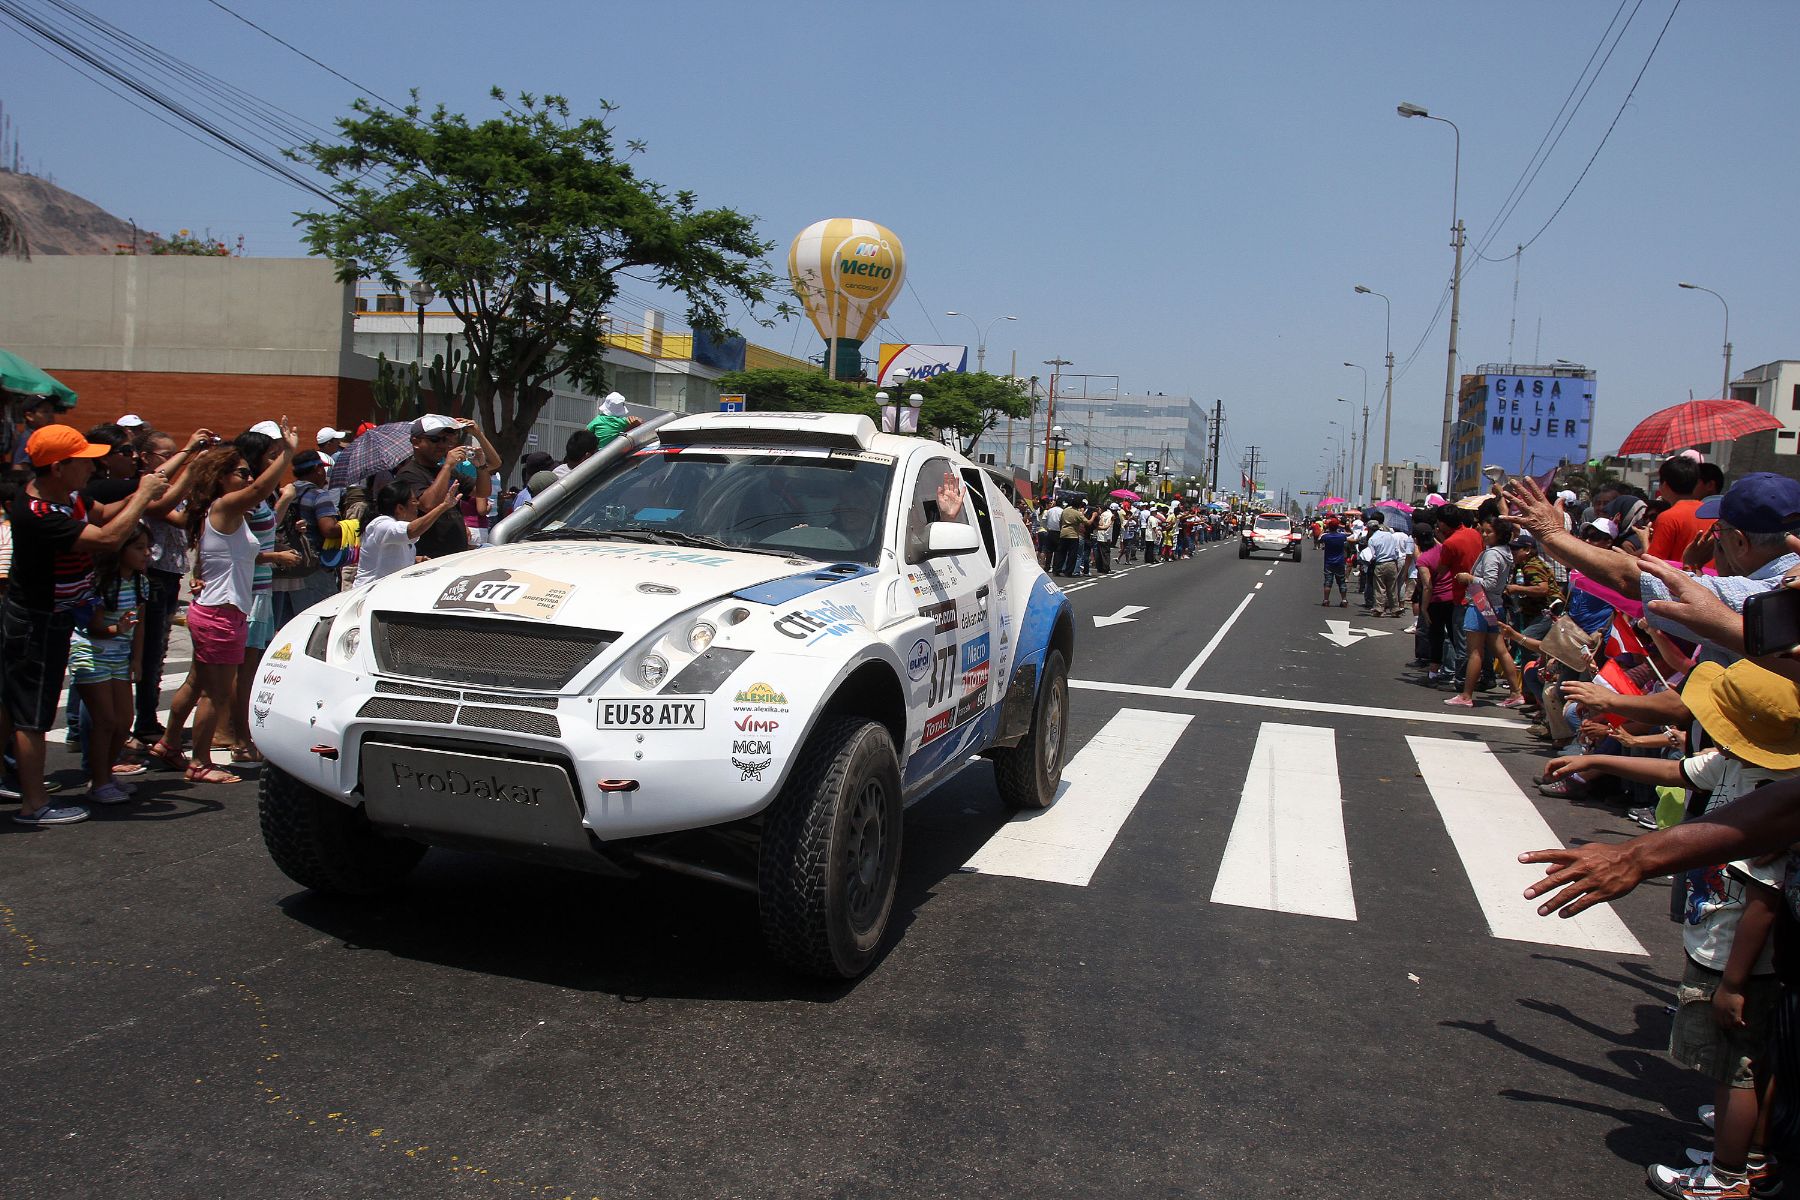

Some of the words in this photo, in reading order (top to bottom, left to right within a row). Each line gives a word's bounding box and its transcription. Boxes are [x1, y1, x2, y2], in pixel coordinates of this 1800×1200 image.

[841, 259, 891, 279] Metro
[1496, 379, 1561, 397] CASA
[1499, 400, 1519, 414] DE
[1535, 402, 1555, 415] LA
[1492, 417, 1576, 436] MUJER
[834, 451, 890, 465] dakar.com
[474, 583, 520, 601] 377
[522, 595, 560, 604] ARGENTINA
[536, 602, 556, 610] CHILE
[961, 609, 988, 630] dakar.com
[910, 652, 928, 670] eurol
[927, 644, 957, 708] 377
[969, 667, 988, 689] TOTAL
[735, 690, 788, 704] ALEXIKA
[604, 704, 654, 725] EU58
[658, 704, 696, 725] ATX
[733, 705, 789, 714] www.alexika.eu
[734, 714, 780, 733] VIMP
[926, 718, 947, 738] TOTAL
[732, 740, 772, 755] MCM
[392, 762, 543, 806] ProDakar
